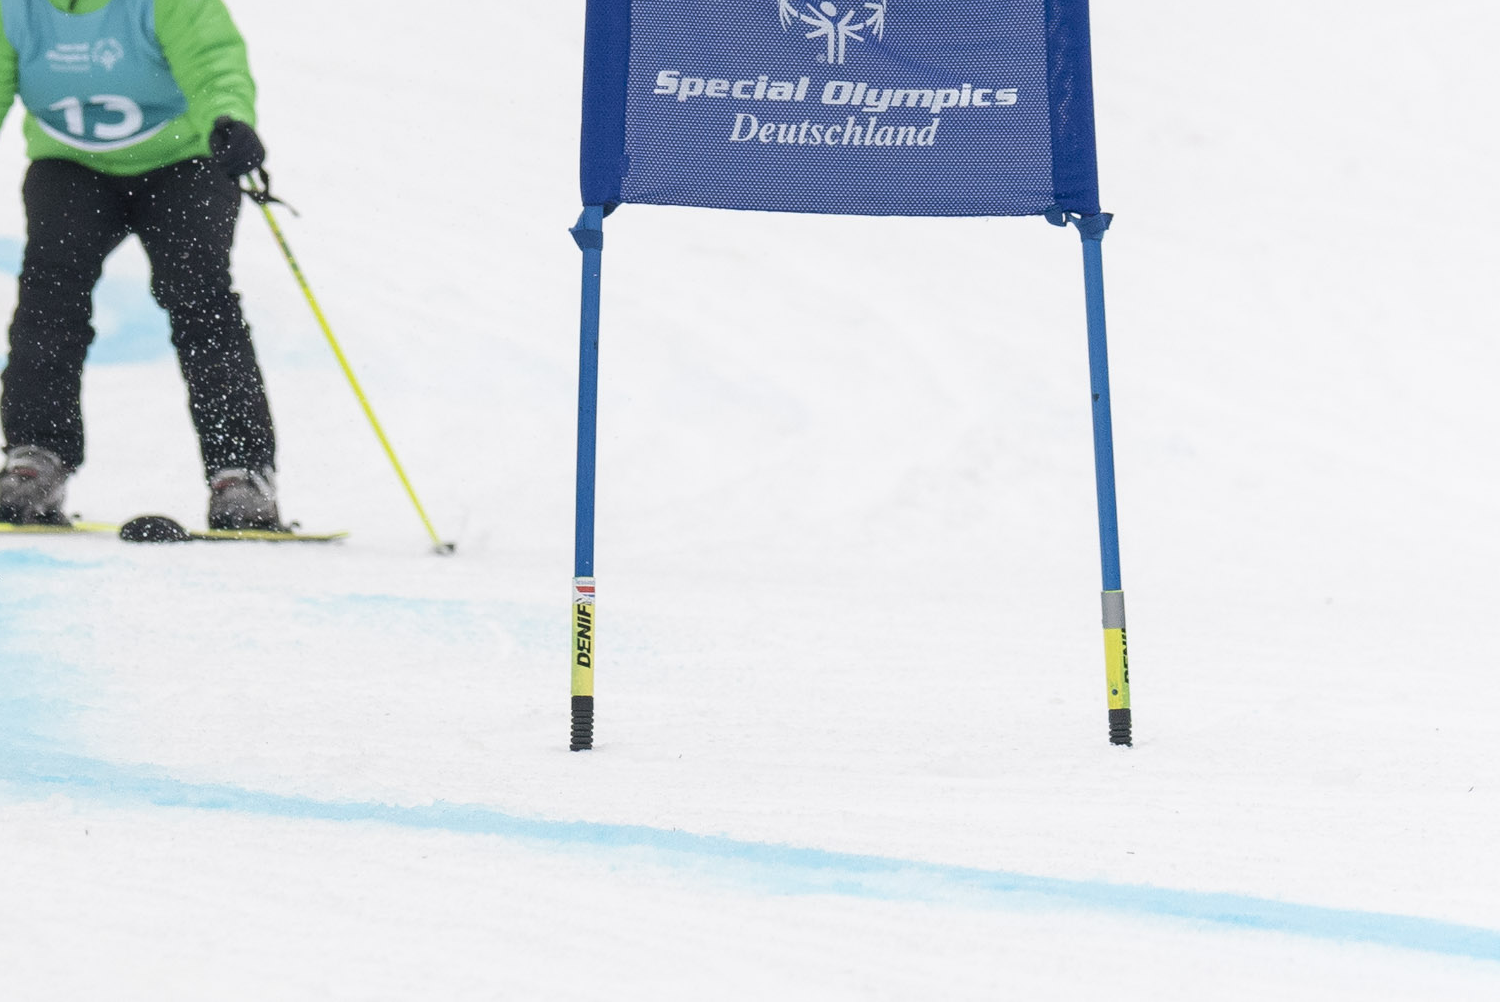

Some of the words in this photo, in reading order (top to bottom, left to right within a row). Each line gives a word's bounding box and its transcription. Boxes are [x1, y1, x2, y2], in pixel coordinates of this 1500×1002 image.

[654, 70, 808, 103] Special
[821, 80, 1018, 114] Olympics
[729, 113, 940, 147] Deutschland
[576, 602, 592, 668] DENIF
